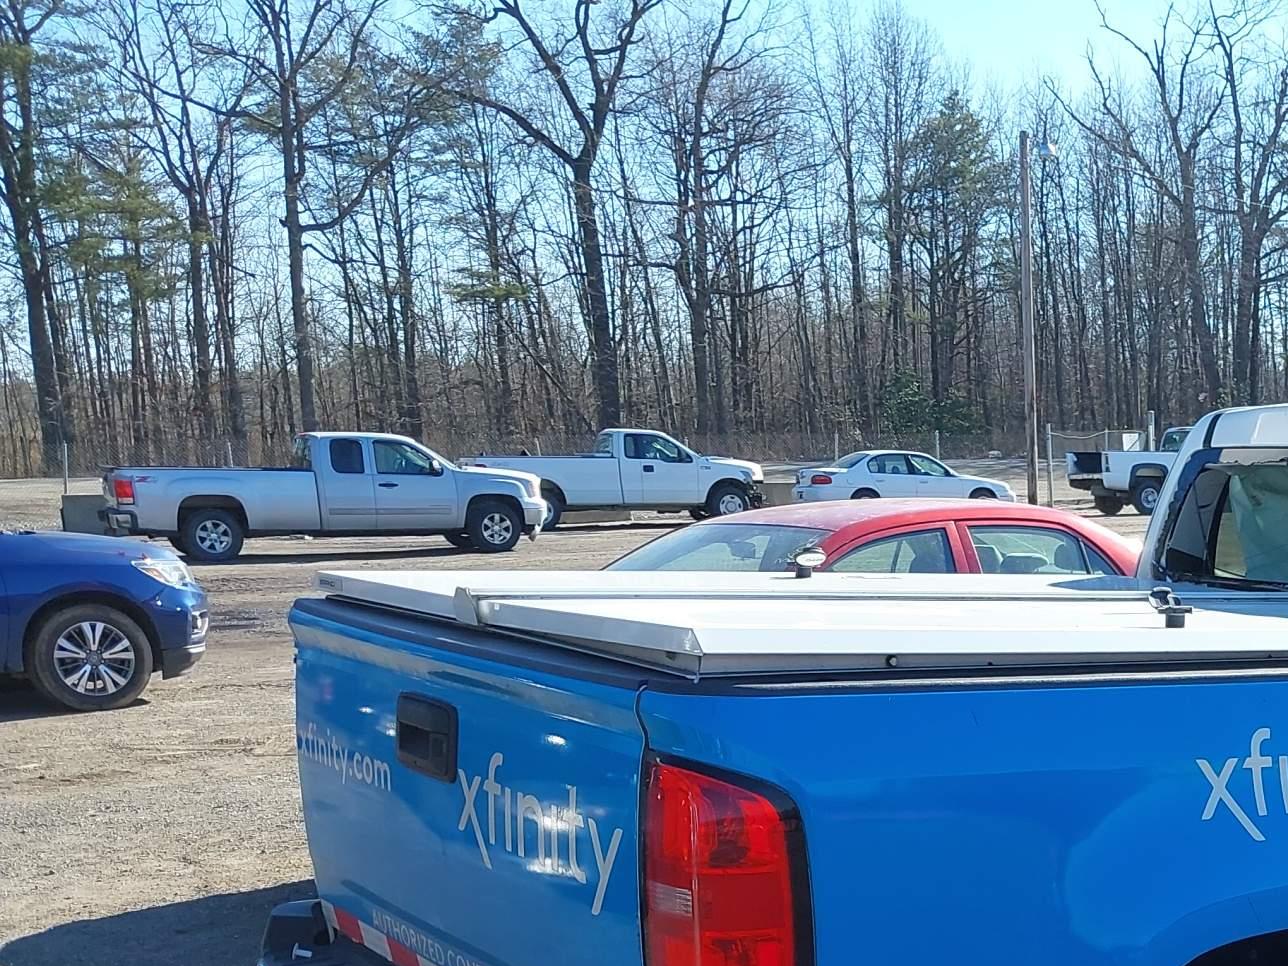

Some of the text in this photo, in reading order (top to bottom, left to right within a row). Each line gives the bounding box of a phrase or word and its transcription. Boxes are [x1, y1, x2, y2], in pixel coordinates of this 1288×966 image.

[299, 721, 392, 792] xfinity.com
[458, 752, 624, 916] xfinity
[371, 909, 445, 965] AUTHORIZED
